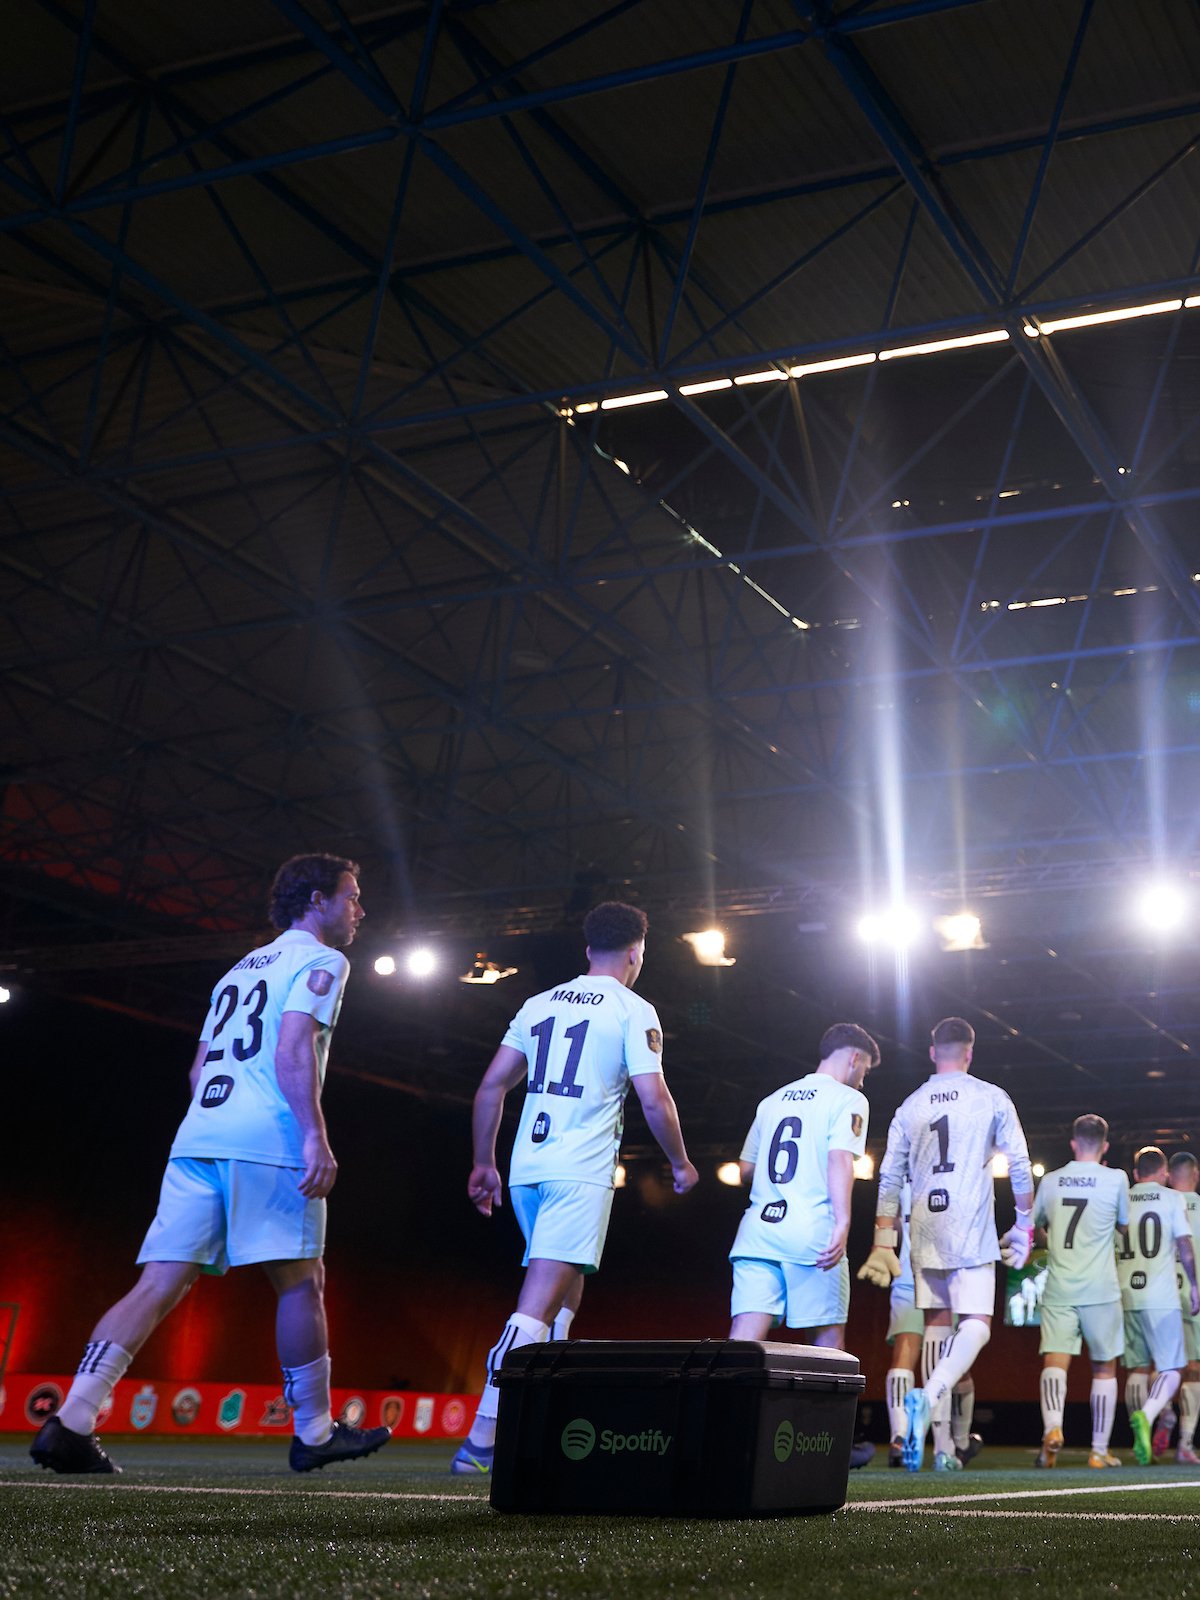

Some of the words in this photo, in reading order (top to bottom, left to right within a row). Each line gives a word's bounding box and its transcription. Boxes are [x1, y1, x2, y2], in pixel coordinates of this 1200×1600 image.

[550, 990, 604, 1005] MANGO
[202, 979, 267, 1067] 23
[527, 1016, 590, 1098] 11
[782, 1089, 817, 1101] FICUS
[930, 1090, 958, 1104] PINO
[768, 1116, 802, 1184] 6
[930, 1114, 955, 1175] 1
[1058, 1177, 1097, 1188] BONSAI
[1062, 1197, 1088, 1249] 7
[1120, 1211, 1161, 1260] 10
[600, 1429, 672, 1456] Spotify
[796, 1431, 833, 1457] Spotify
